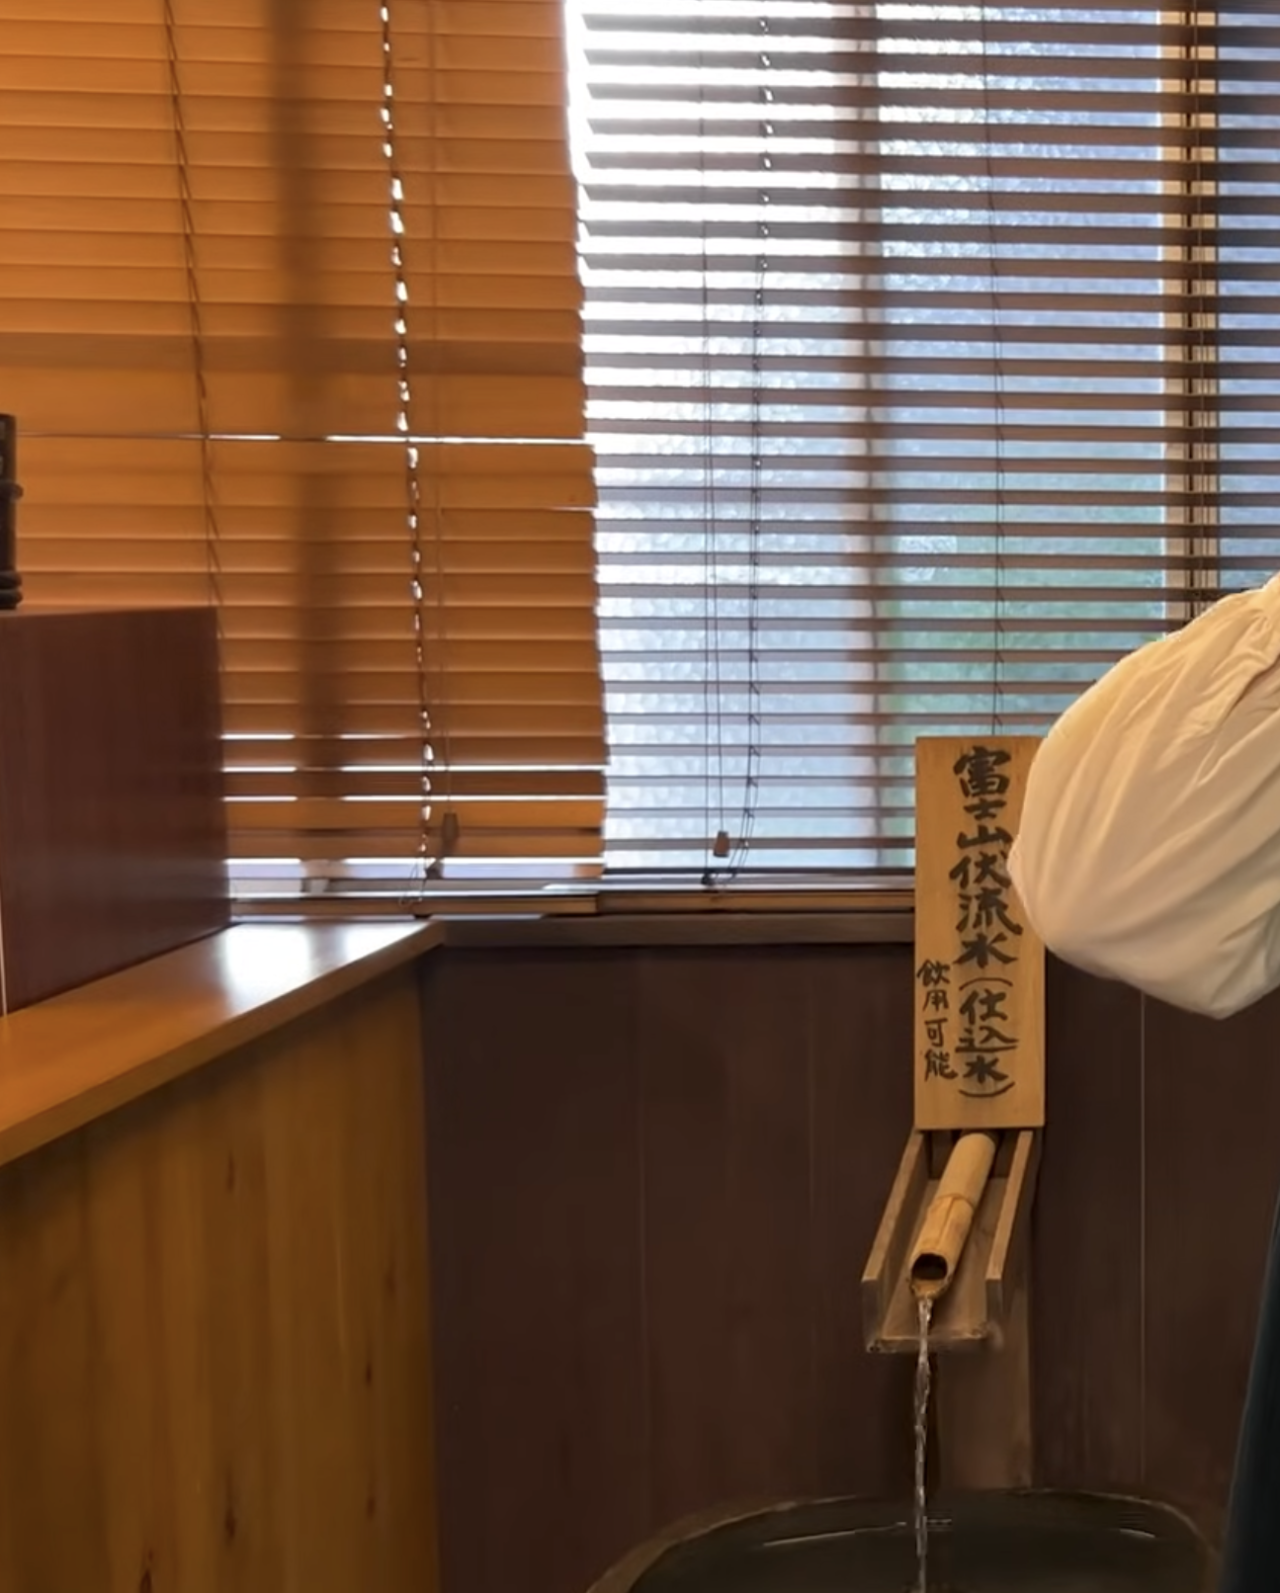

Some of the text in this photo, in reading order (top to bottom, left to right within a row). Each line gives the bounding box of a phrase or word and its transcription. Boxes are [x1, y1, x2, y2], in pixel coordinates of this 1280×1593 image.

[916, 957, 958, 1082] 飲用可能
[949, 745, 1023, 1099] 富士山伏流水（仕込水）
